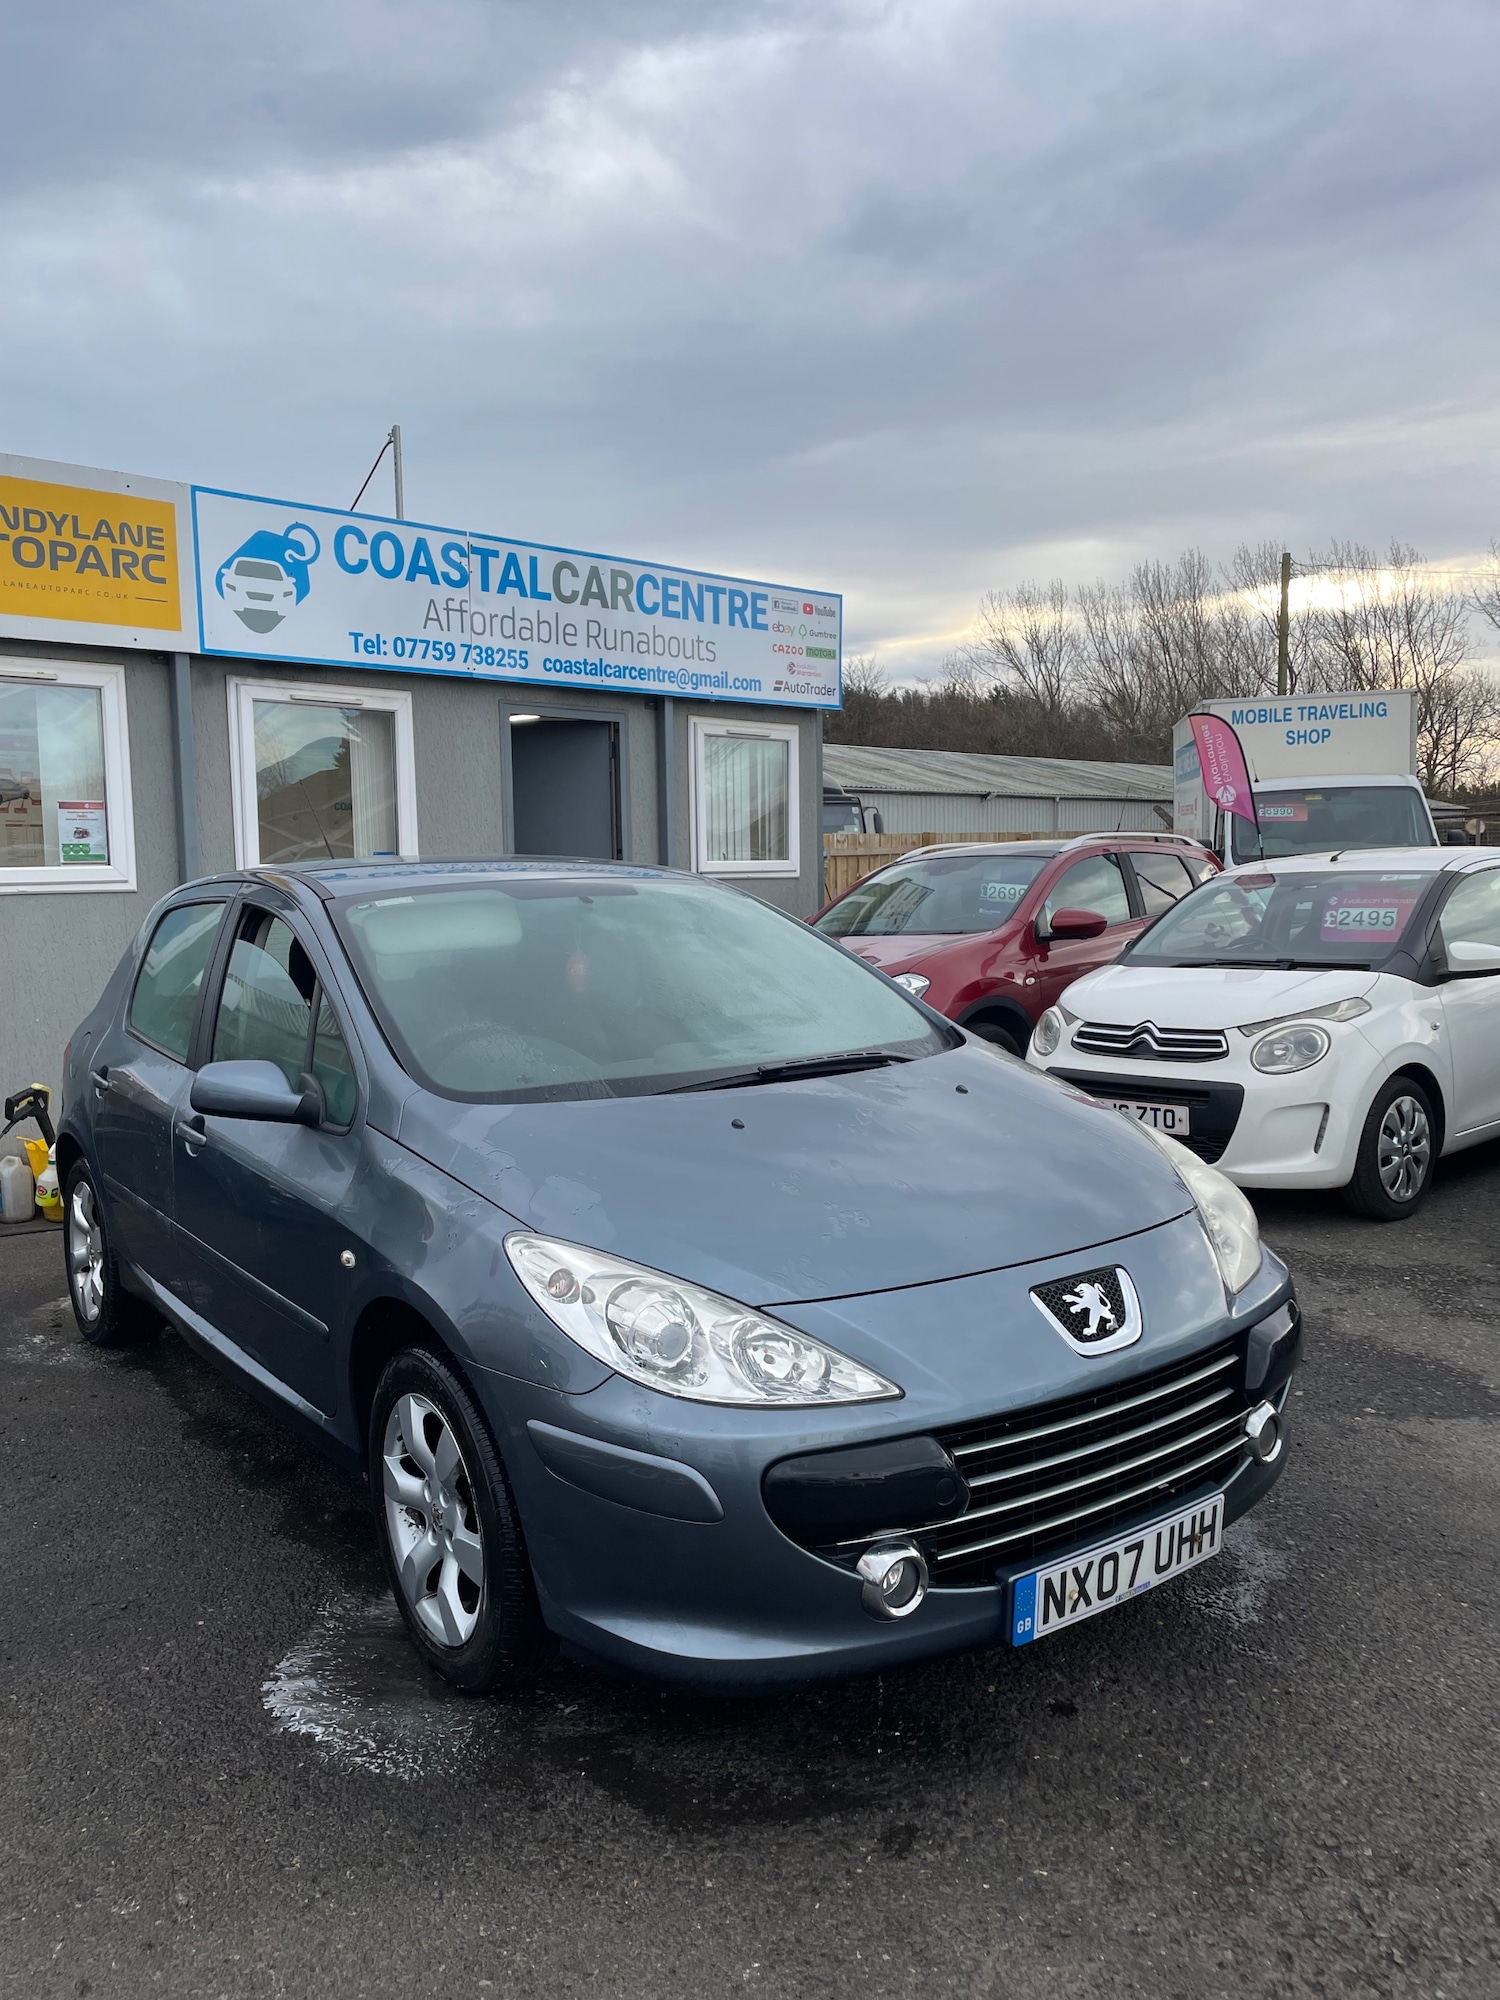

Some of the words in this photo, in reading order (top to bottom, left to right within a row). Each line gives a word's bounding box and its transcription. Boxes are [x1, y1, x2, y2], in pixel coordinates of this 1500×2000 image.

[333, 524, 769, 632] COASTALCARCENTRE
[815, 604, 837, 618] YouTube
[422, 597, 578, 647] Affordable
[586, 619, 717, 663] Runabouts
[772, 620, 796, 637] ebay
[809, 629, 837, 640] Gumtree
[348, 631, 388, 656] Tel:
[393, 636, 456, 662] 07759
[460, 643, 529, 670] 738255
[772, 643, 804, 656] CAZOO
[542, 656, 762, 692] coastalcarcentre@gmail.com
[783, 680, 837, 697] AutoTrader
[1231, 706, 1293, 726] MOBILE
[1297, 701, 1388, 721] TRAVELING
[1285, 728, 1331, 746] SHOP
[1323, 910, 1396, 929] £2495
[1042, 1539, 1144, 1626] NX07
[1154, 1504, 1218, 1576] UHH
[1016, 1616, 1032, 1634] GB
